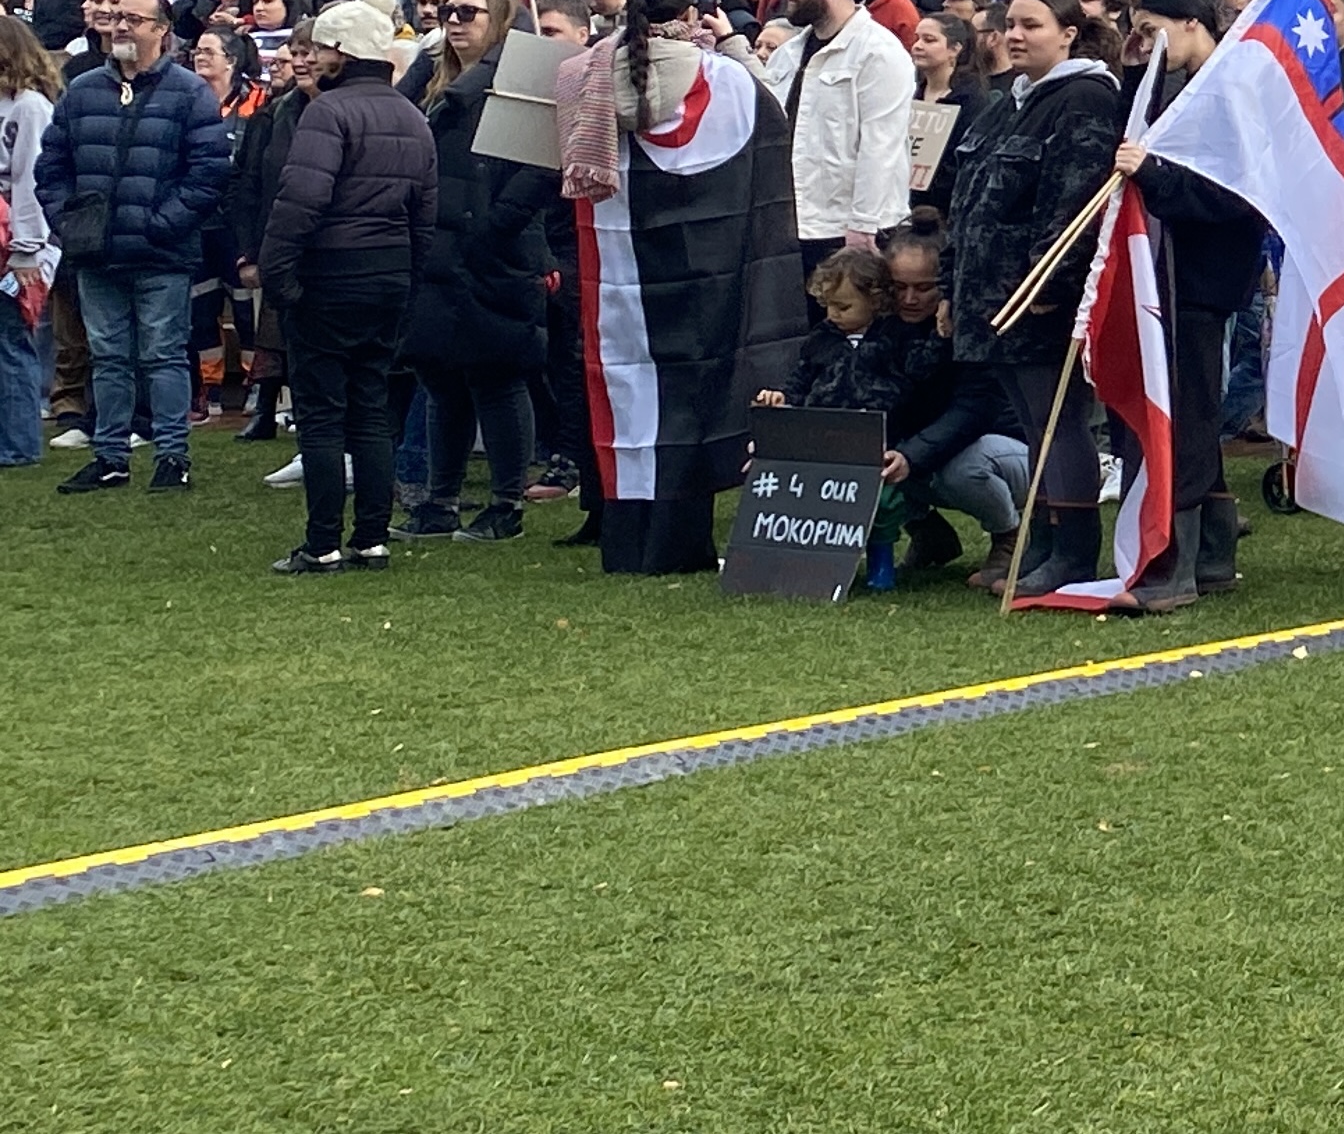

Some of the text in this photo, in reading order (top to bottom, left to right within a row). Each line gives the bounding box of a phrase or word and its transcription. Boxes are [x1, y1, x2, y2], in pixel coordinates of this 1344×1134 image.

[752, 471, 858, 503] # 4 OUR
[752, 511, 864, 548] MOKOPUNA
